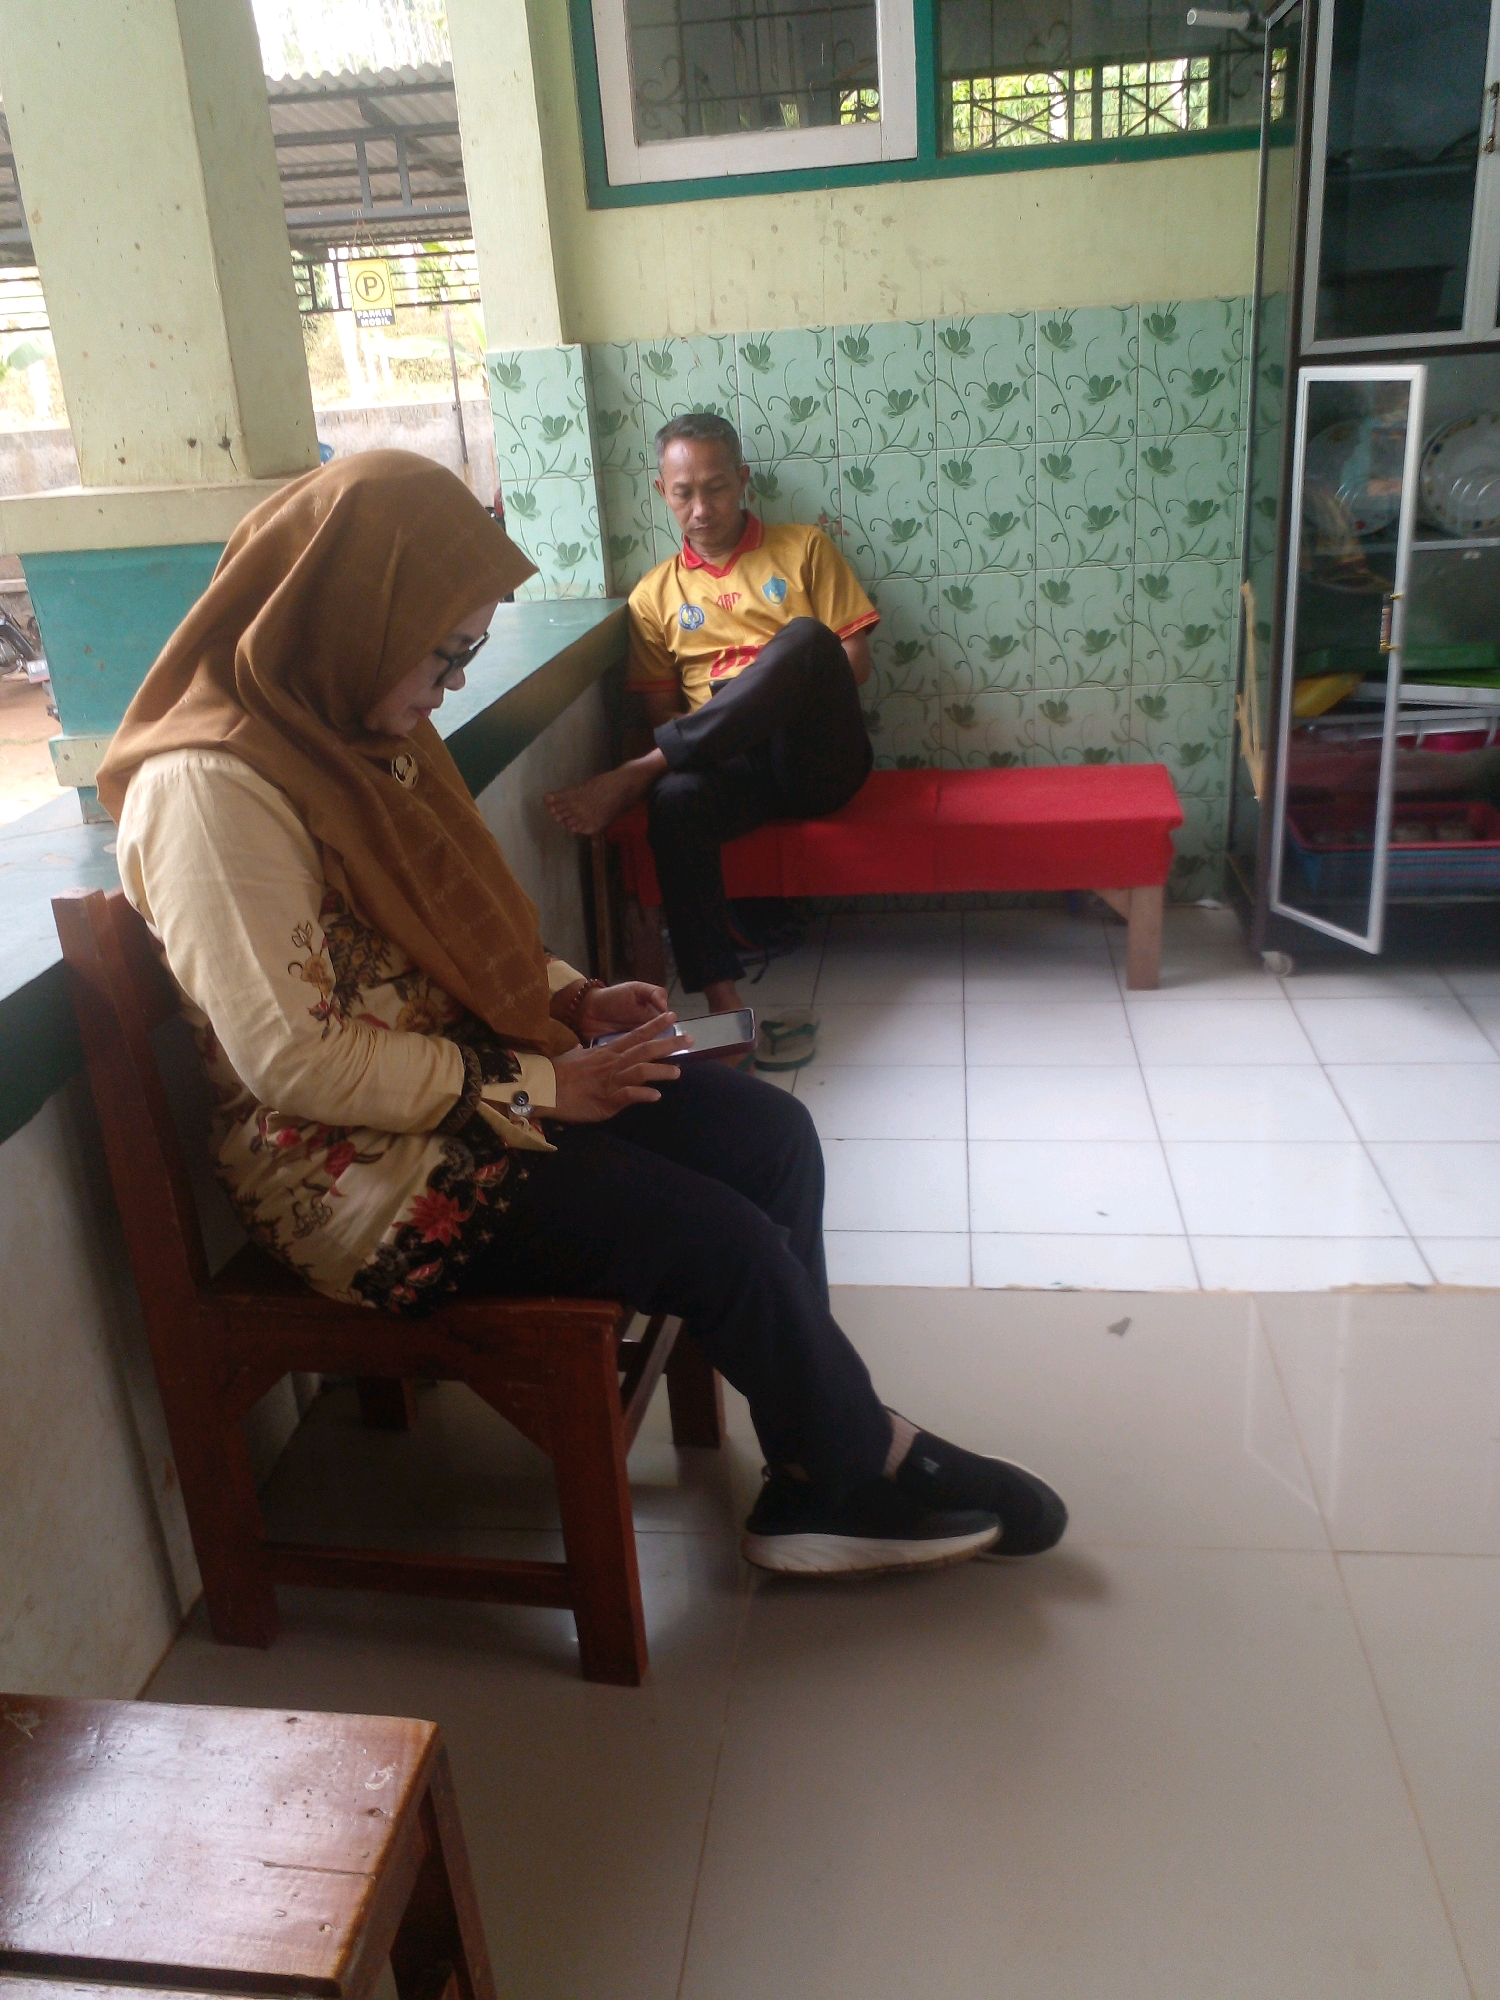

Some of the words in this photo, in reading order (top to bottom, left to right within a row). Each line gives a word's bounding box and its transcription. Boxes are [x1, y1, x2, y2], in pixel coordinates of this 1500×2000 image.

[363, 276, 378, 296] P
[356, 308, 393, 319] PARKIR
[360, 317, 391, 327] MOBIL
